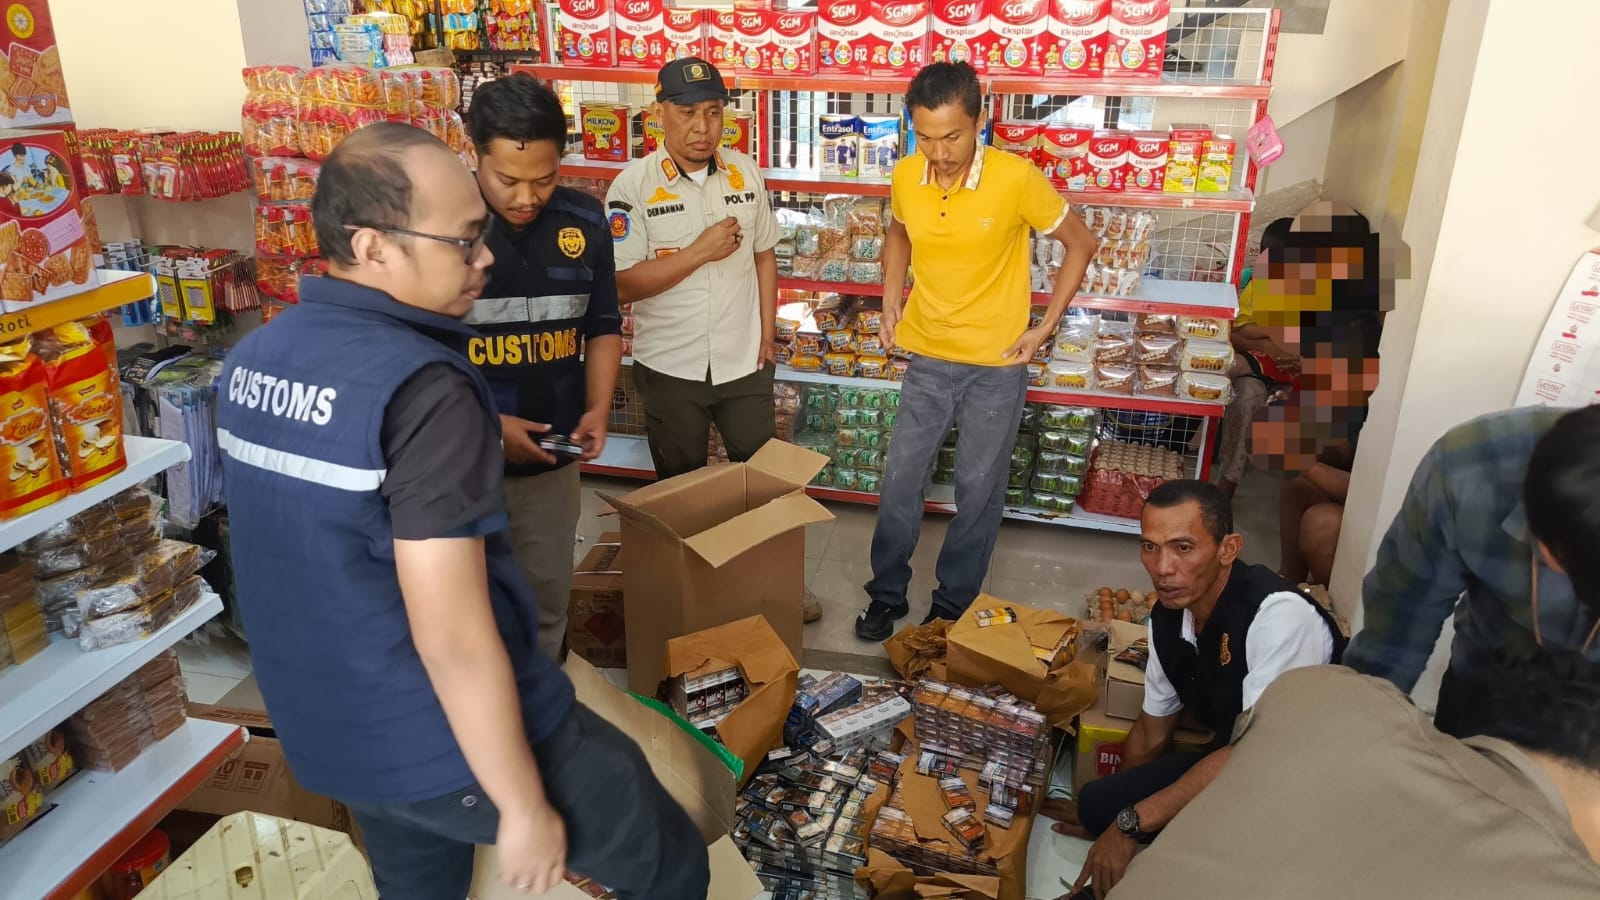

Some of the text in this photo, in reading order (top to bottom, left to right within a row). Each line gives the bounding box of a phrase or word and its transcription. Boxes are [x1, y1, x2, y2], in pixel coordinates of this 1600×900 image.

[573, 0, 594, 12] SGM
[628, 1, 650, 14] SGM
[832, 5, 856, 18] SGM
[886, 5, 913, 19] SGM
[948, 4, 975, 18] SGM
[1005, 3, 1033, 17] SGM
[1065, 4, 1094, 18] SGM
[1124, 4, 1153, 17] SGM
[671, 14, 691, 24] SGM
[720, 15, 734, 25] SG
[741, 17, 761, 29] SGM
[780, 17, 801, 29] SGM
[586, 117, 616, 126] MILKOW
[822, 124, 854, 134] Entrasol
[863, 126, 896, 135] Entrasol
[1007, 129, 1025, 138] SGM
[1058, 133, 1077, 142] SGM
[1098, 143, 1118, 153] SGM
[1138, 143, 1159, 153] SGM
[724, 192, 755, 206] POL PP
[647, 203, 685, 217] DERMAWAN
[468, 328, 577, 366] CUSTOMS
[229, 366, 337, 426] CUSTOMS
